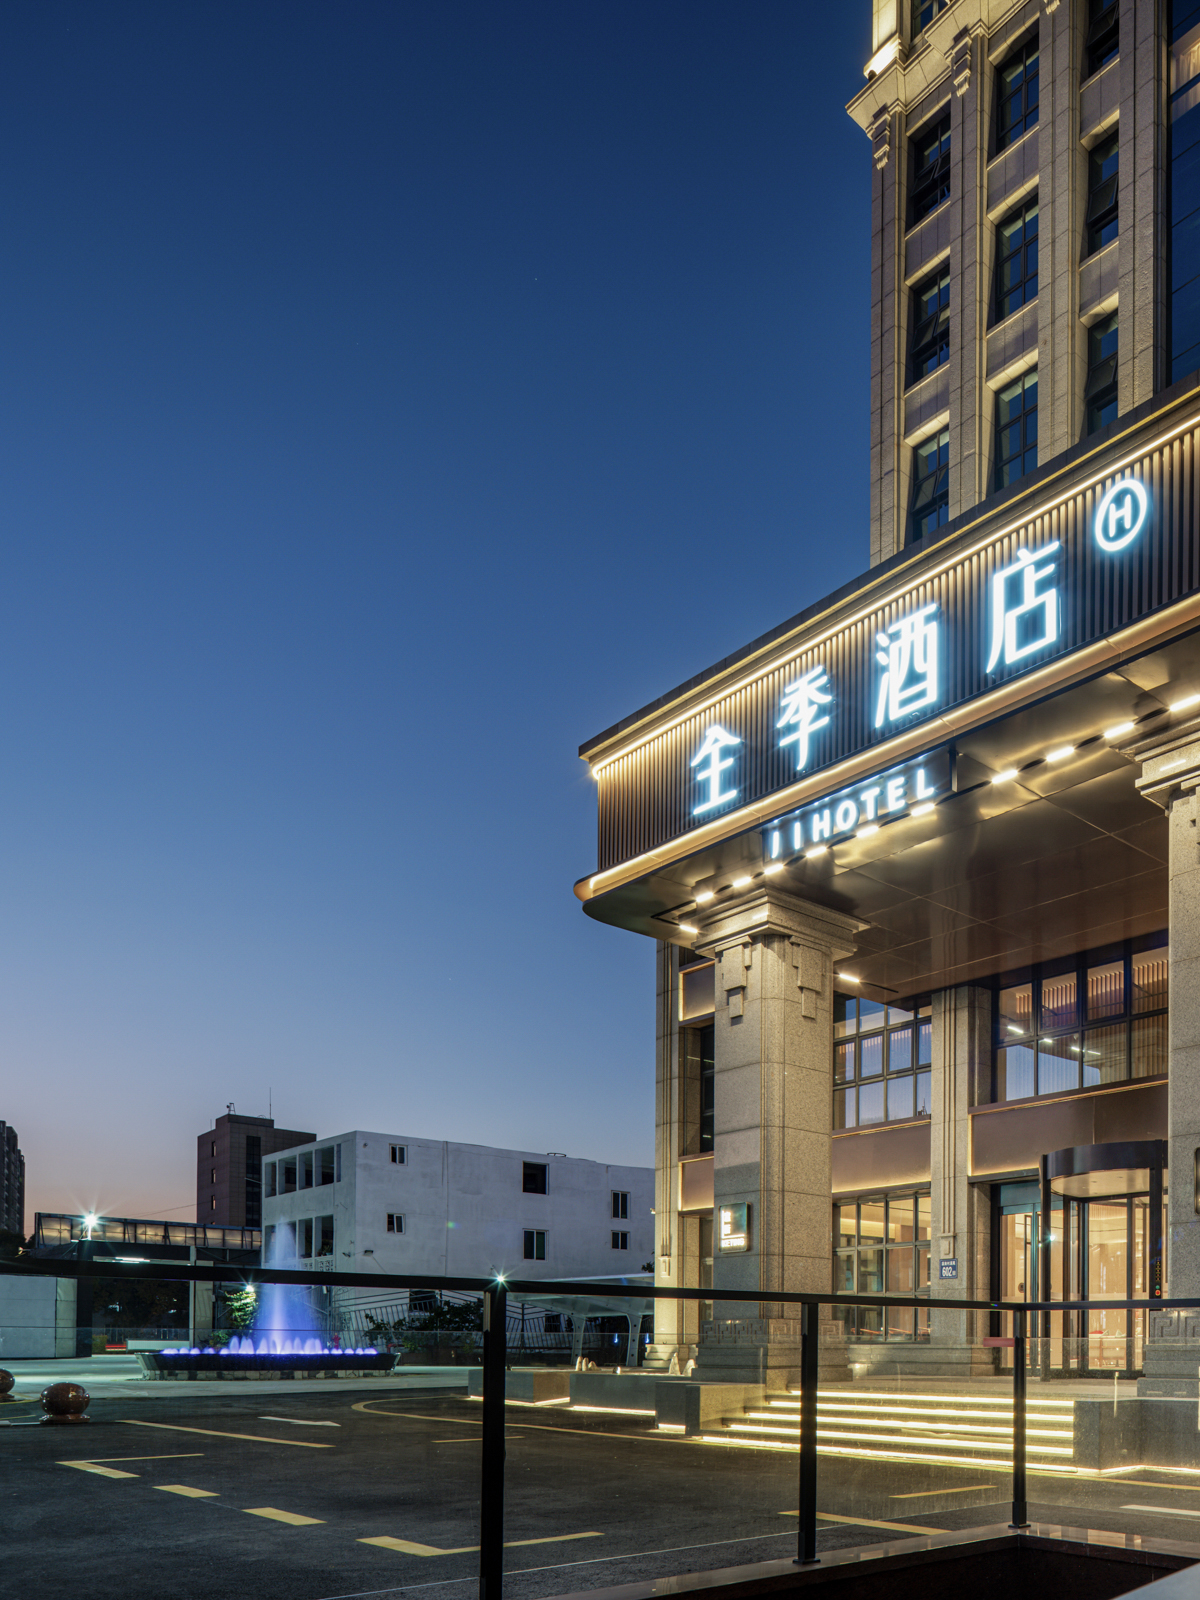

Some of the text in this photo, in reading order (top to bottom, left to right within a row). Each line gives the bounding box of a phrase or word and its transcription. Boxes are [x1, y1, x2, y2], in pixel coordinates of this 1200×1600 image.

[690, 540, 1061, 816] 全季酒店
[941, 1266, 956, 1277] 602
